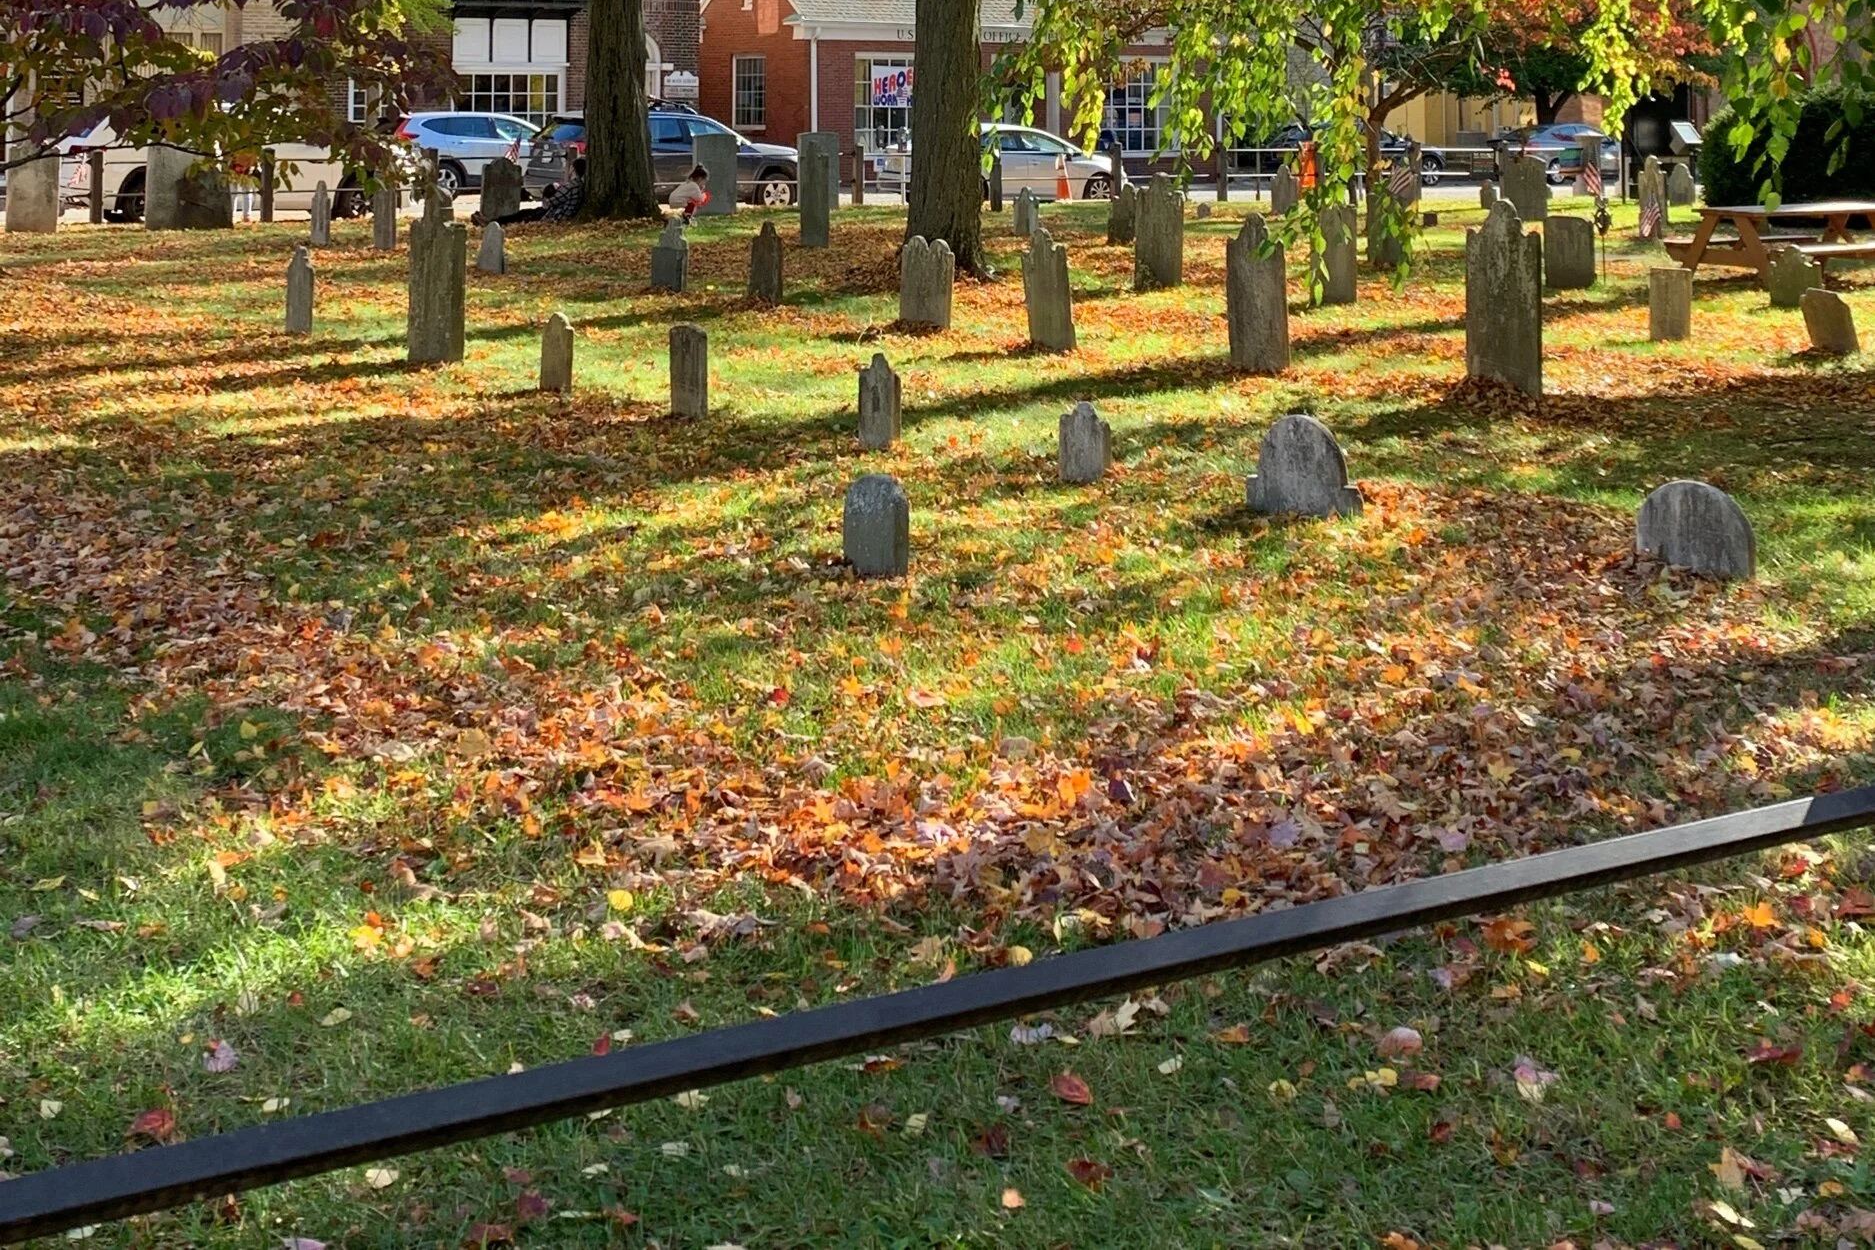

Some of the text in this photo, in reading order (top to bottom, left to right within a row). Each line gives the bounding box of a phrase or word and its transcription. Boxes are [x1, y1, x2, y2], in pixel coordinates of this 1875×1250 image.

[983, 31, 1022, 42] OFFICE
[874, 69, 913, 95] HEROE
[873, 93, 898, 107] WORK
